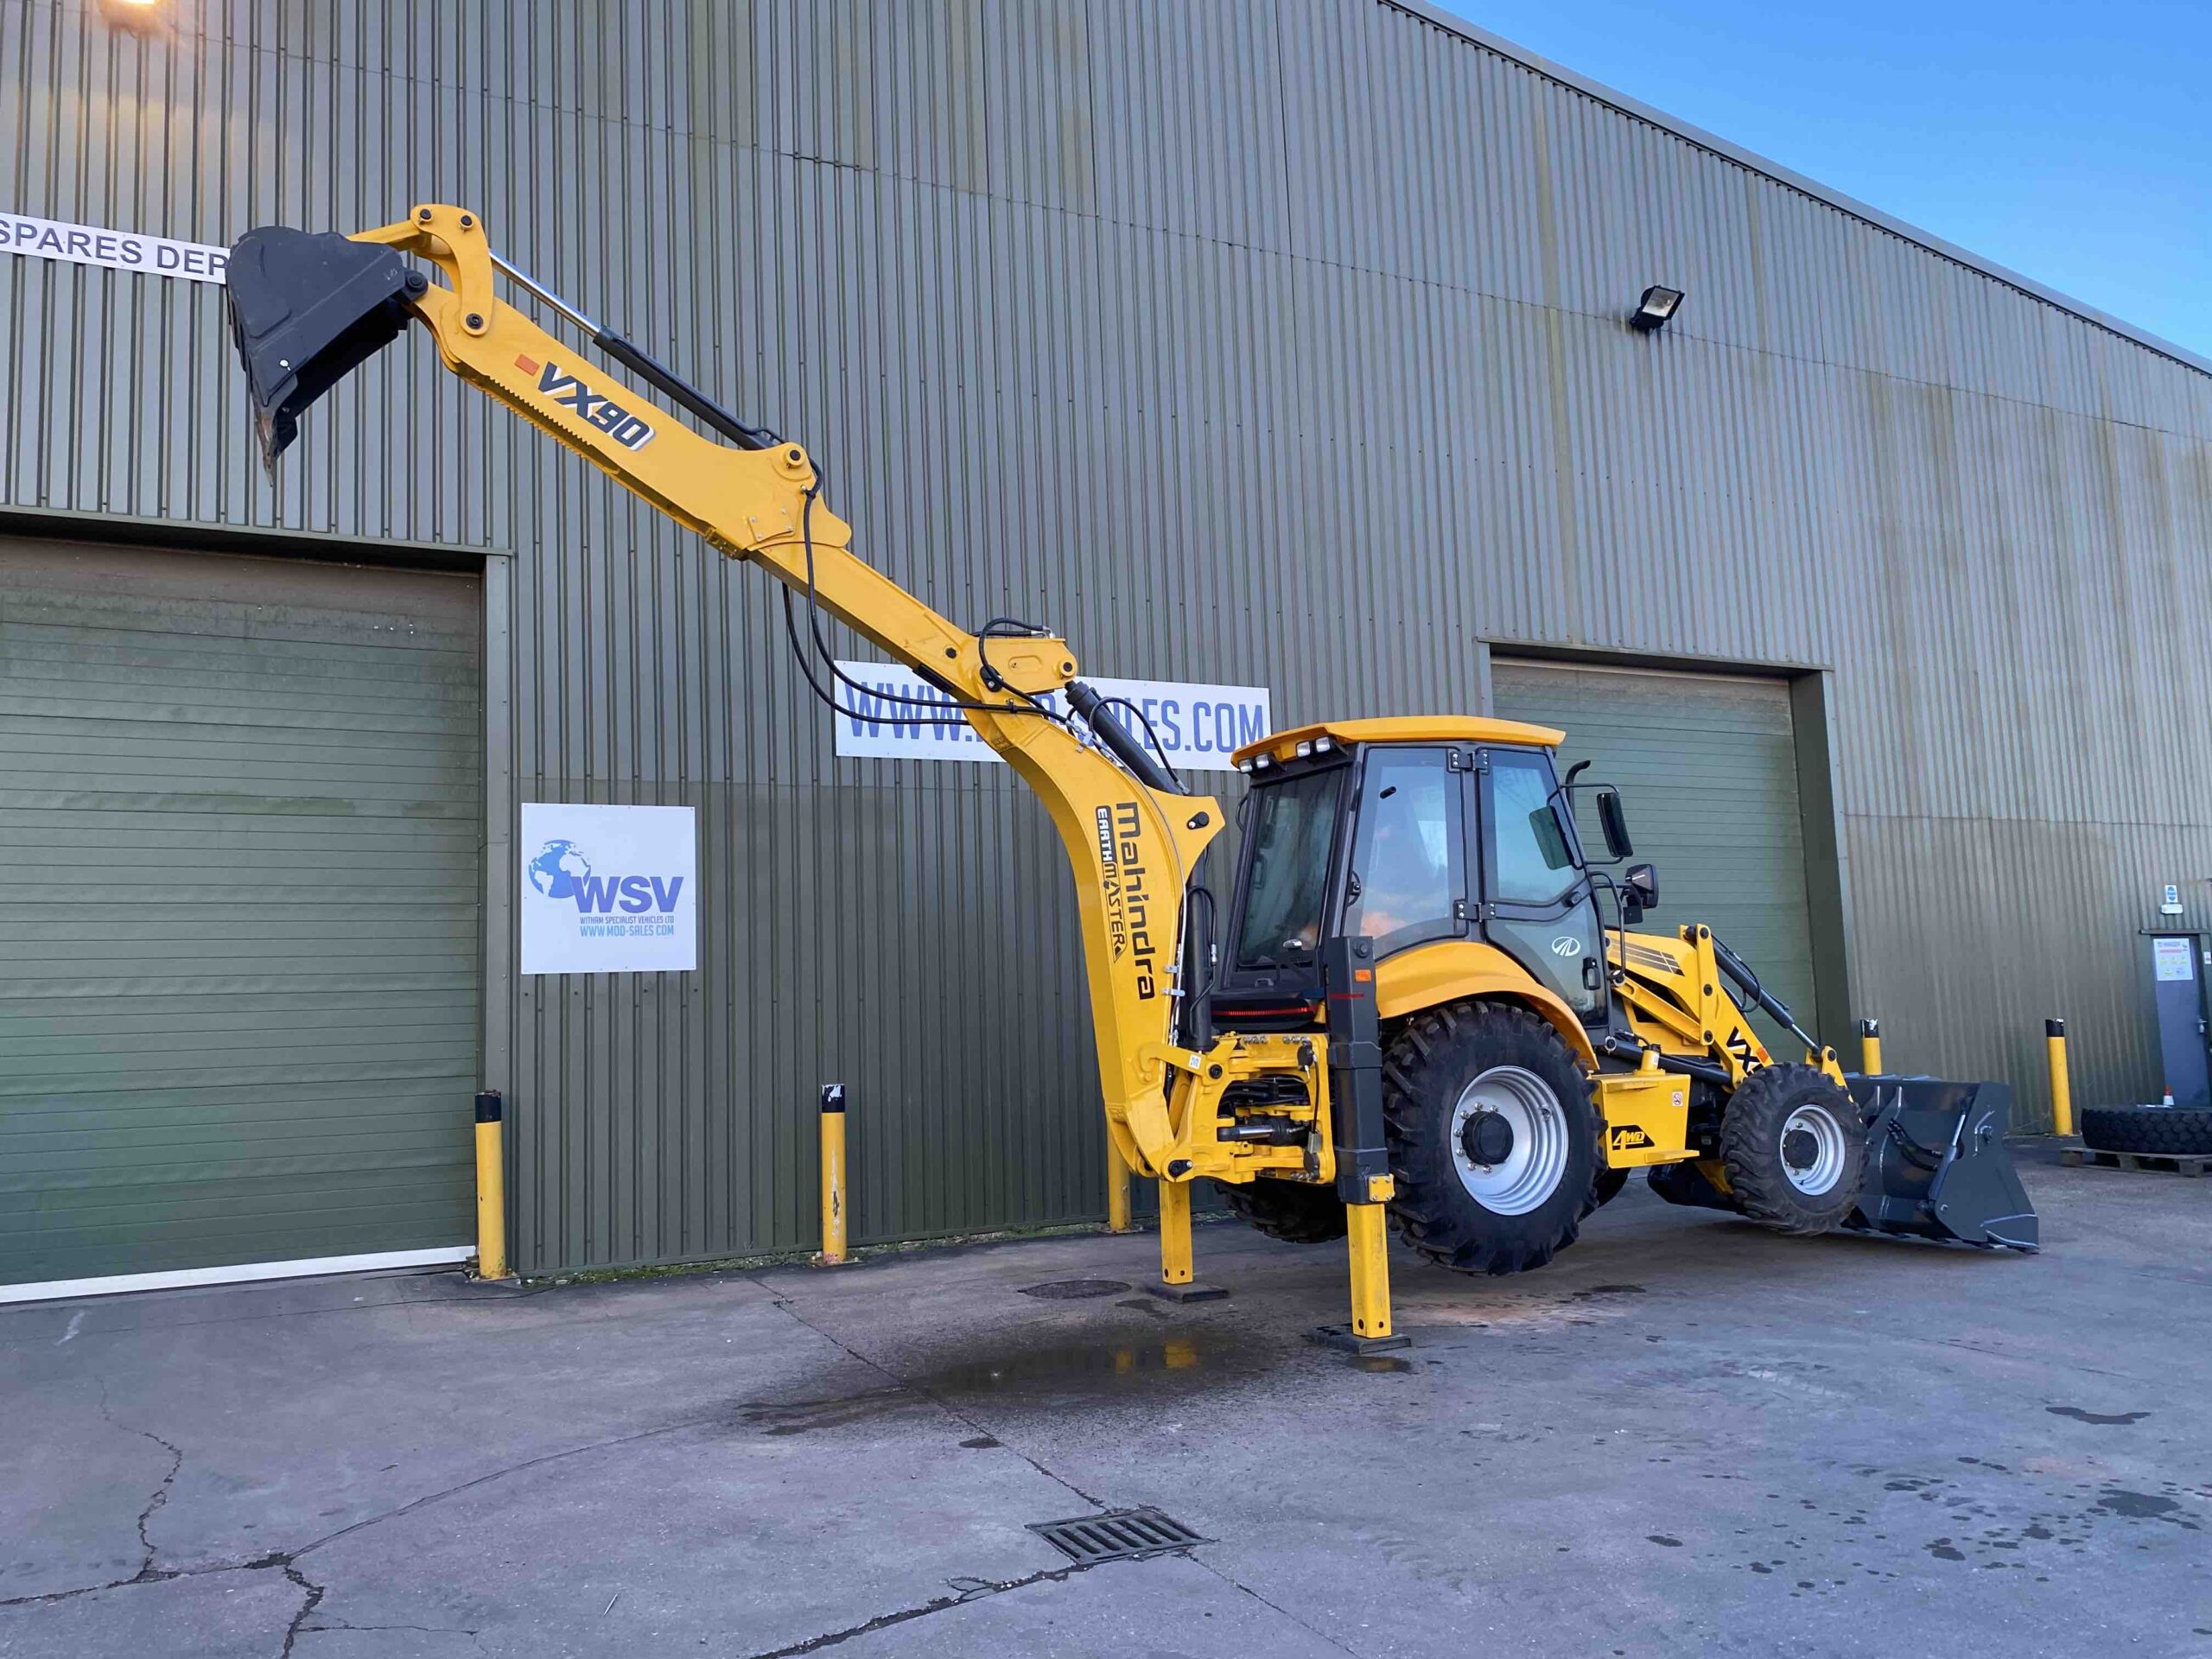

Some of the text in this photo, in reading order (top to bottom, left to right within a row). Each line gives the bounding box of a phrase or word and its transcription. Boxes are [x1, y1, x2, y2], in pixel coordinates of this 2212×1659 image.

[538, 361, 655, 450] VX90
[845, 681, 1263, 753] WWW.LES.COM
[570, 875, 684, 913] WSV
[1116, 802, 1156, 1000] mahindra
[580, 925, 674, 937] WWWMOD-SALESCOM
[605, 916, 637, 925] SPECIALIST
[664, 915, 675, 924] LTD
[1726, 1026, 1764, 1077] VX
[1612, 1130, 1645, 1150] 4WD
